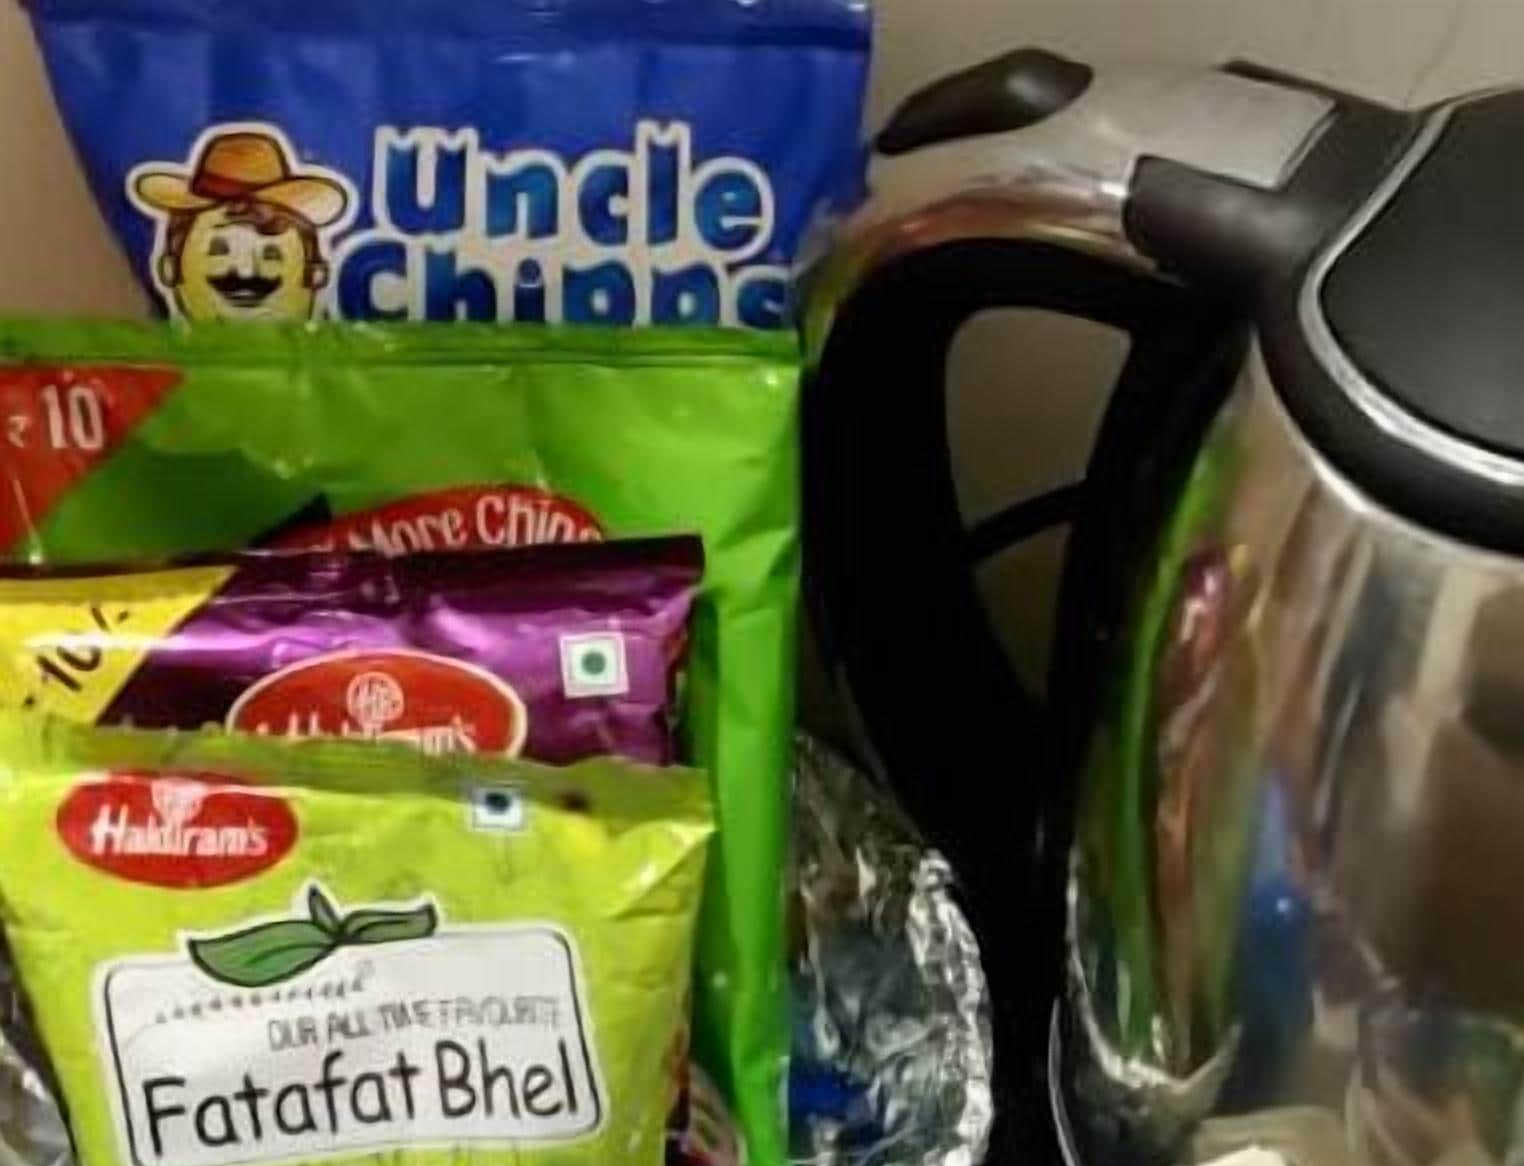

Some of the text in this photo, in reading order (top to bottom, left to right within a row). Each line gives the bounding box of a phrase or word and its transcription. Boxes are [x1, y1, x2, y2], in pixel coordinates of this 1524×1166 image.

[375, 122, 772, 260] Uncle
[142, 1037, 577, 1157] Fatafat Bhel
